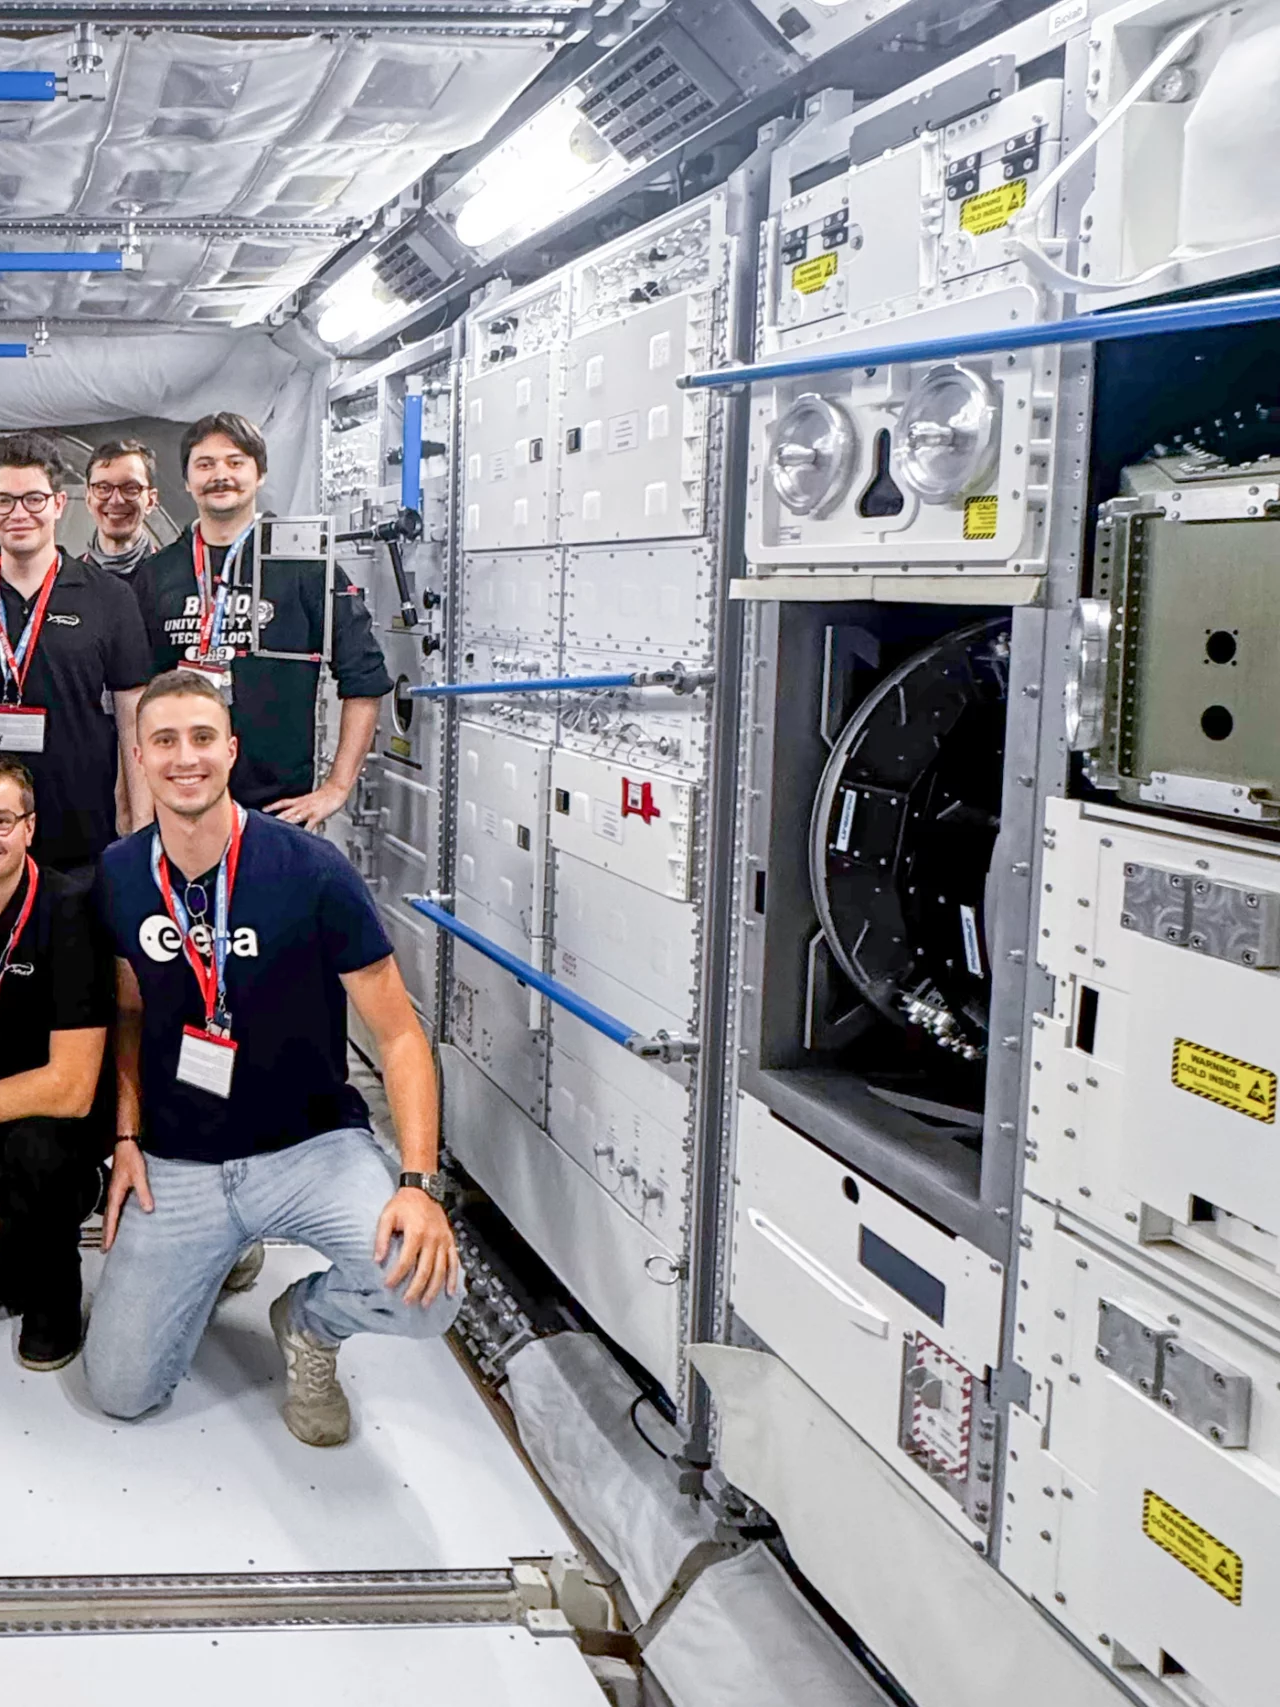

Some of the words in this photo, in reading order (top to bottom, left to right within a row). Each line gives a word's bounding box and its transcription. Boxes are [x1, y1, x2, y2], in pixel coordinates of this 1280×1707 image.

[183, 594, 252, 617] BO
[170, 632, 255, 646] TECHLOGY
[1180, 1062, 1207, 1078] COLD
[1208, 1073, 1241, 1093] INSIDE
[1191, 1054, 1237, 1078] WARNING
[1150, 1514, 1176, 1538] COLD
[1177, 1536, 1208, 1563] INSIDE
[1160, 1510, 1205, 1548] WARNING
